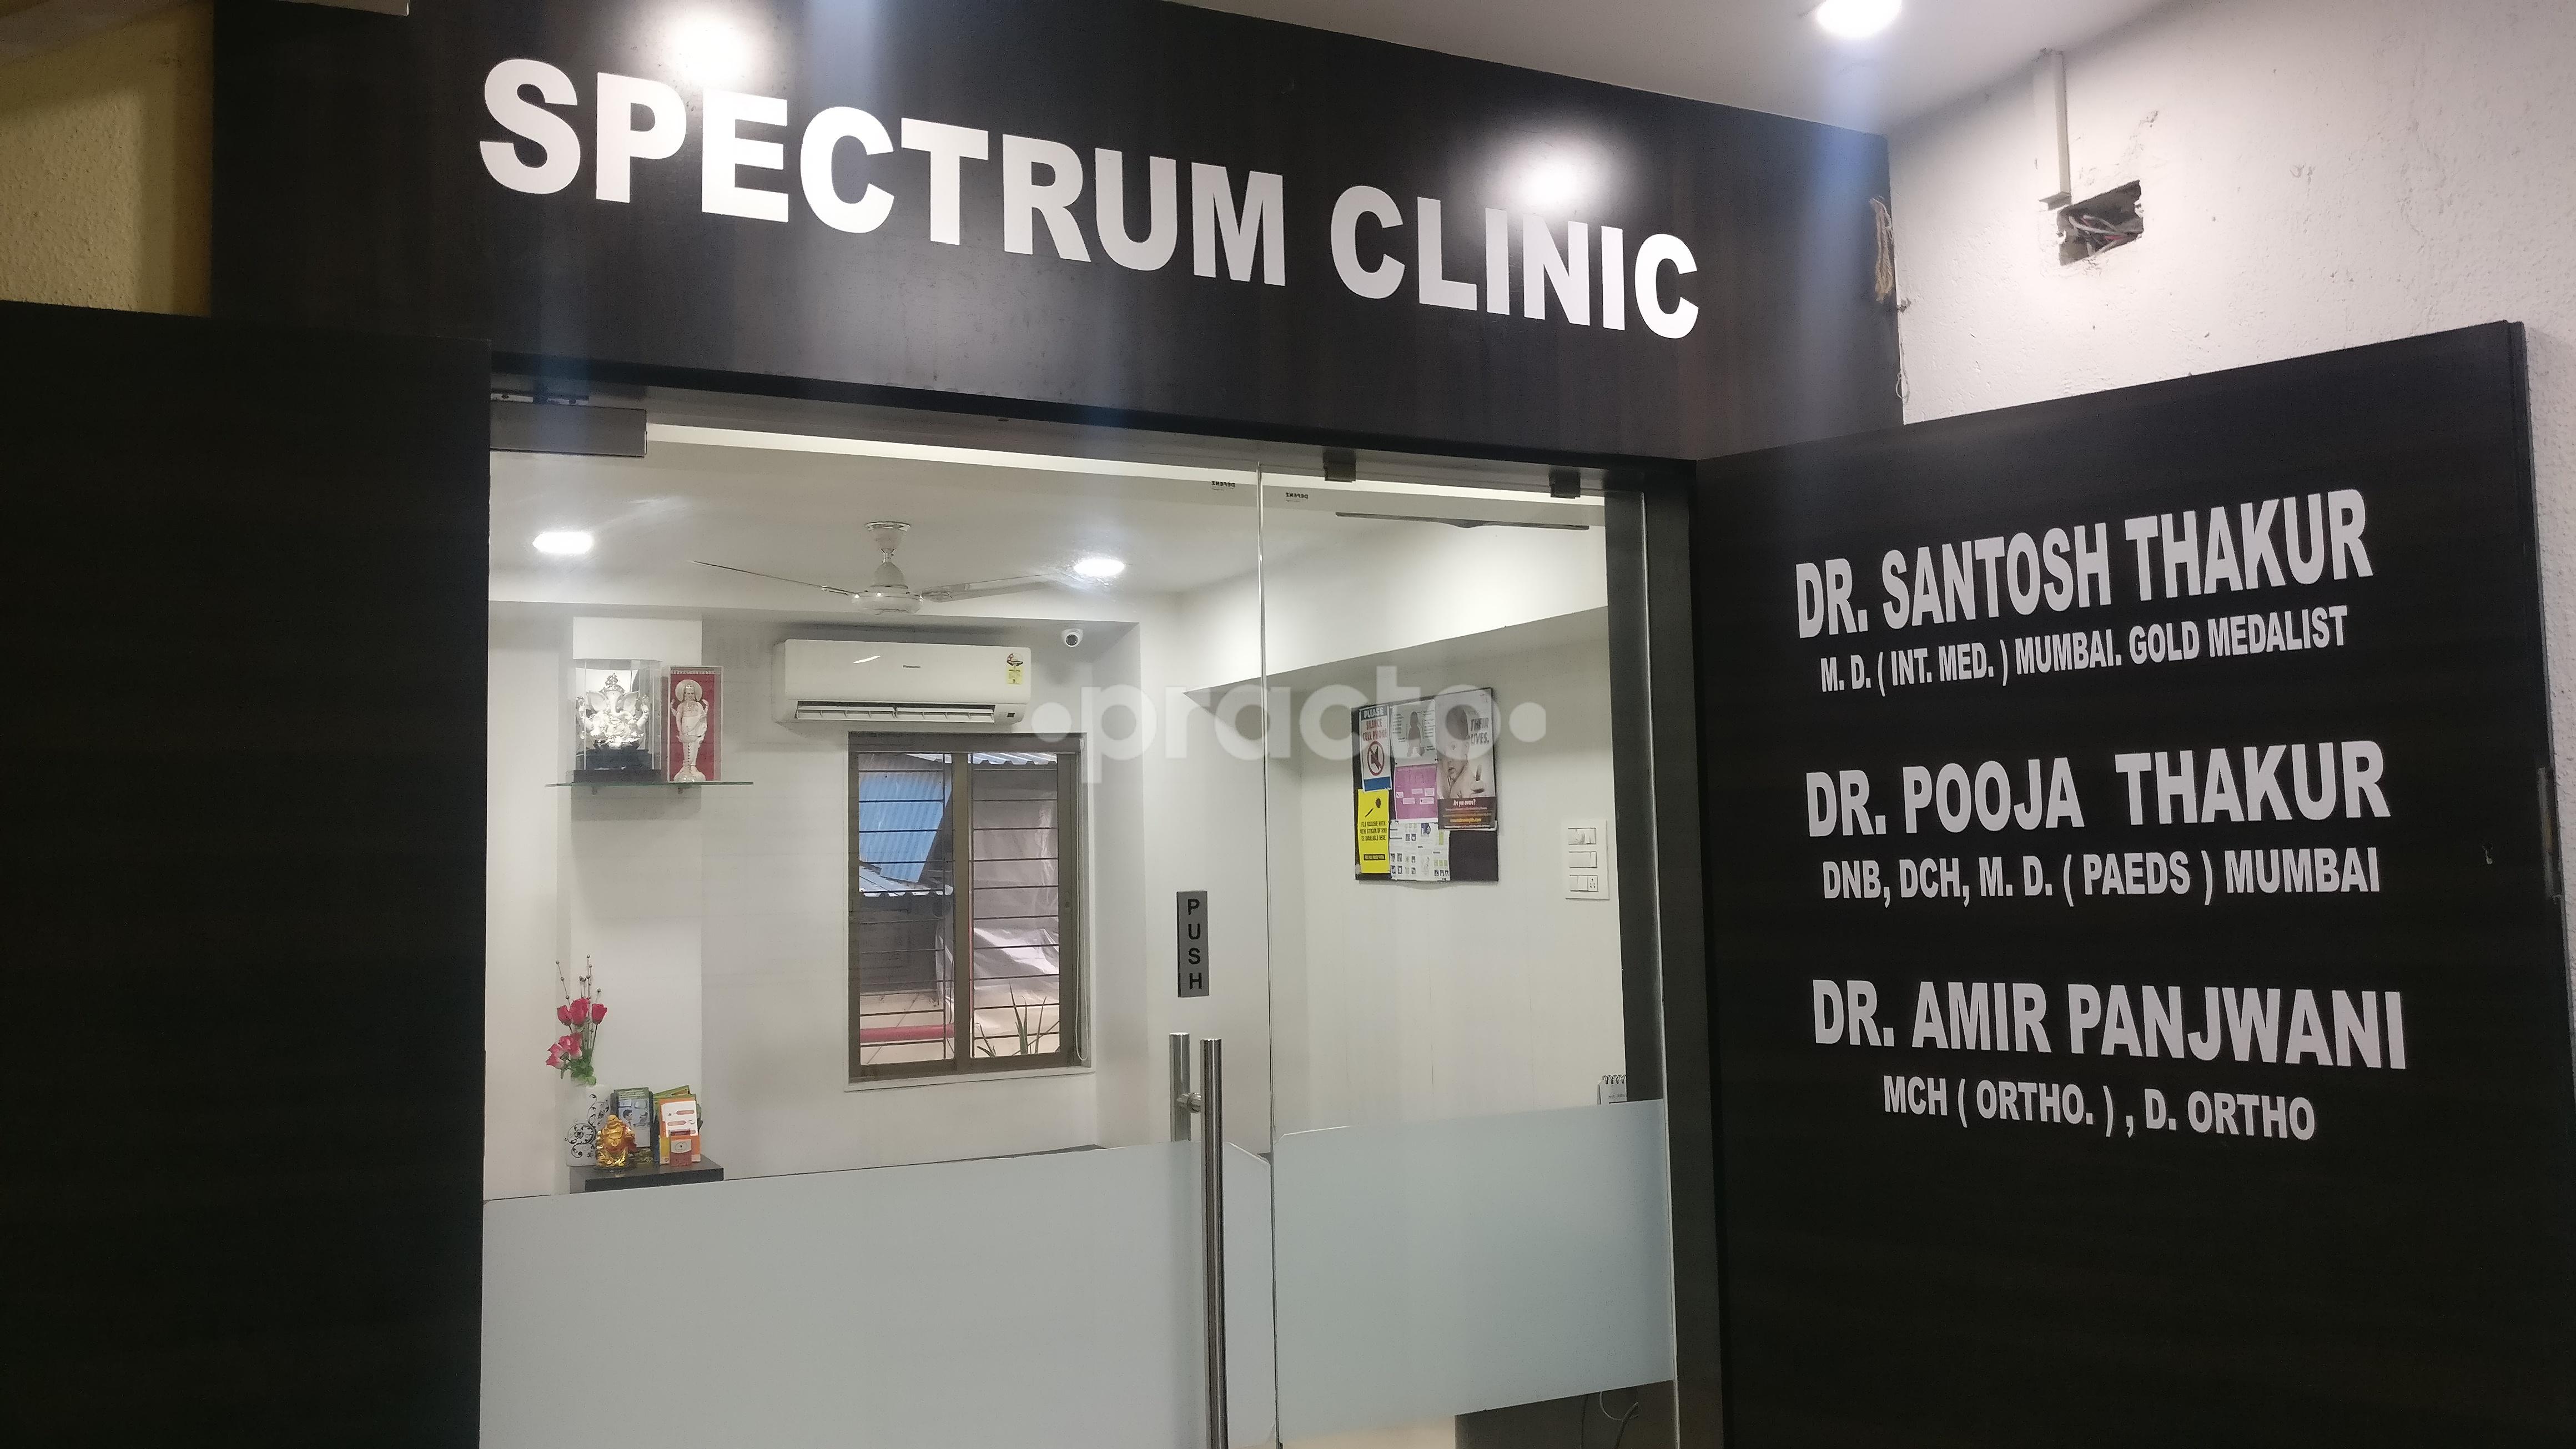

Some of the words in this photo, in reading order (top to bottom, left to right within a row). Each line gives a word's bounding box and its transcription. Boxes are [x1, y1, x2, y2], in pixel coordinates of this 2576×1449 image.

[480, 58, 1285, 286] SPECTRUM
[1331, 186, 1699, 339] CLINIC
[1796, 559, 1868, 638] DR.
[1882, 522, 2111, 629] SANTOSH
[2125, 489, 2373, 601] THAKUR
[1939, 643, 1994, 681] MED.
[2015, 629, 2121, 675] MUMBAI.
[2129, 621, 2199, 664] GOLD
[2207, 605, 2347, 657] MEDALIST
[1364, 707, 1383, 719] PLEASE
[1807, 770, 1886, 837] DR.
[1903, 757, 2085, 833] POOJA
[2115, 741, 2391, 825] THAKUR
[1823, 861, 1890, 908] DNB,
[1899, 858, 1969, 907] DCH,
[2084, 851, 2190, 894] PAEDS
[2225, 847, 2379, 893] MUMBAI
[1188, 899, 1203, 990] PUSH
[1813, 980, 1894, 1046] DR.
[1912, 982, 2051, 1053] AMIR
[2068, 984, 2406, 1069] PANJWANI
[1884, 1075, 1947, 1115] MCH
[1976, 1080, 2093, 1124] ORTHO.
[2145, 1089, 2176, 1130] D.
[2188, 1091, 2315, 1140] ORTHO
